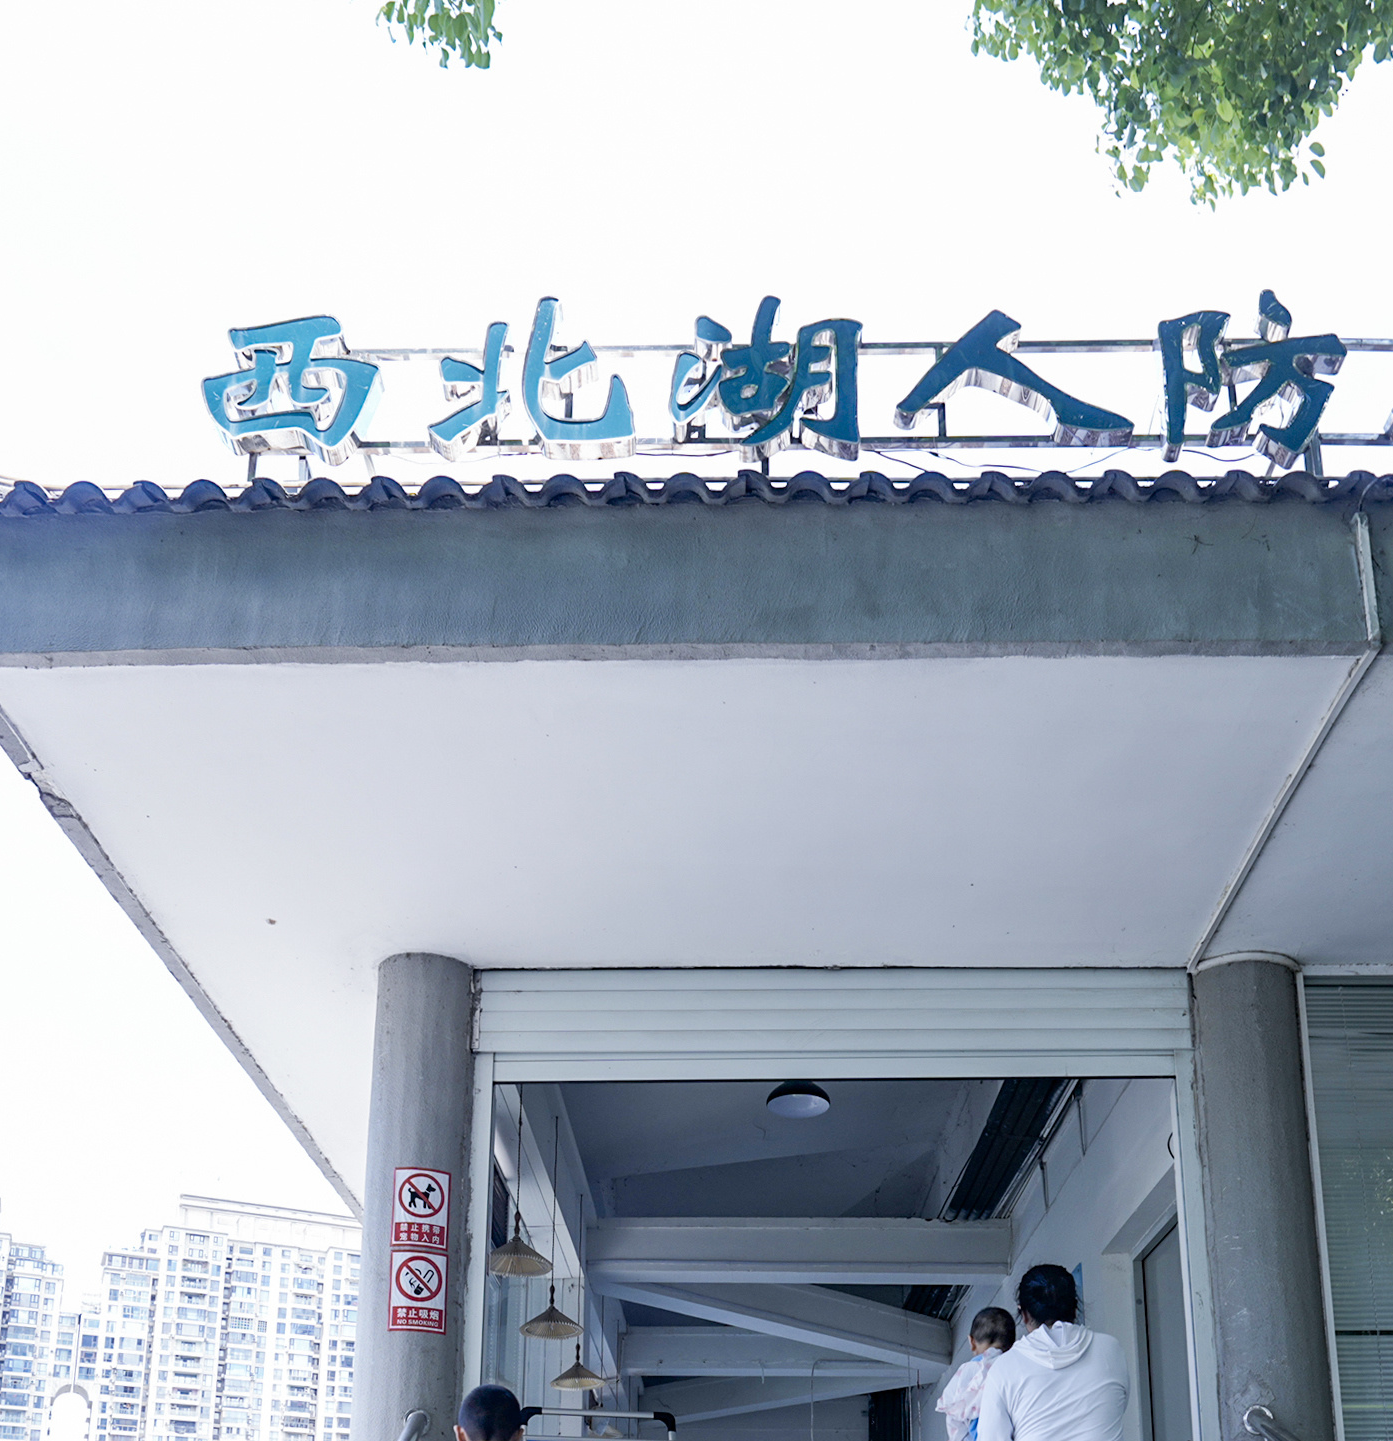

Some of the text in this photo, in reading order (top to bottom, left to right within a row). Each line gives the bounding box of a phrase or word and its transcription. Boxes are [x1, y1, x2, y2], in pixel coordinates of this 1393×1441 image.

[399, 1223, 441, 1234] 禁止携带
[399, 1232, 440, 1244] 宠物入内
[396, 1307, 439, 1321] 禁止吸烟
[407, 1319, 439, 1328] SMOKING
